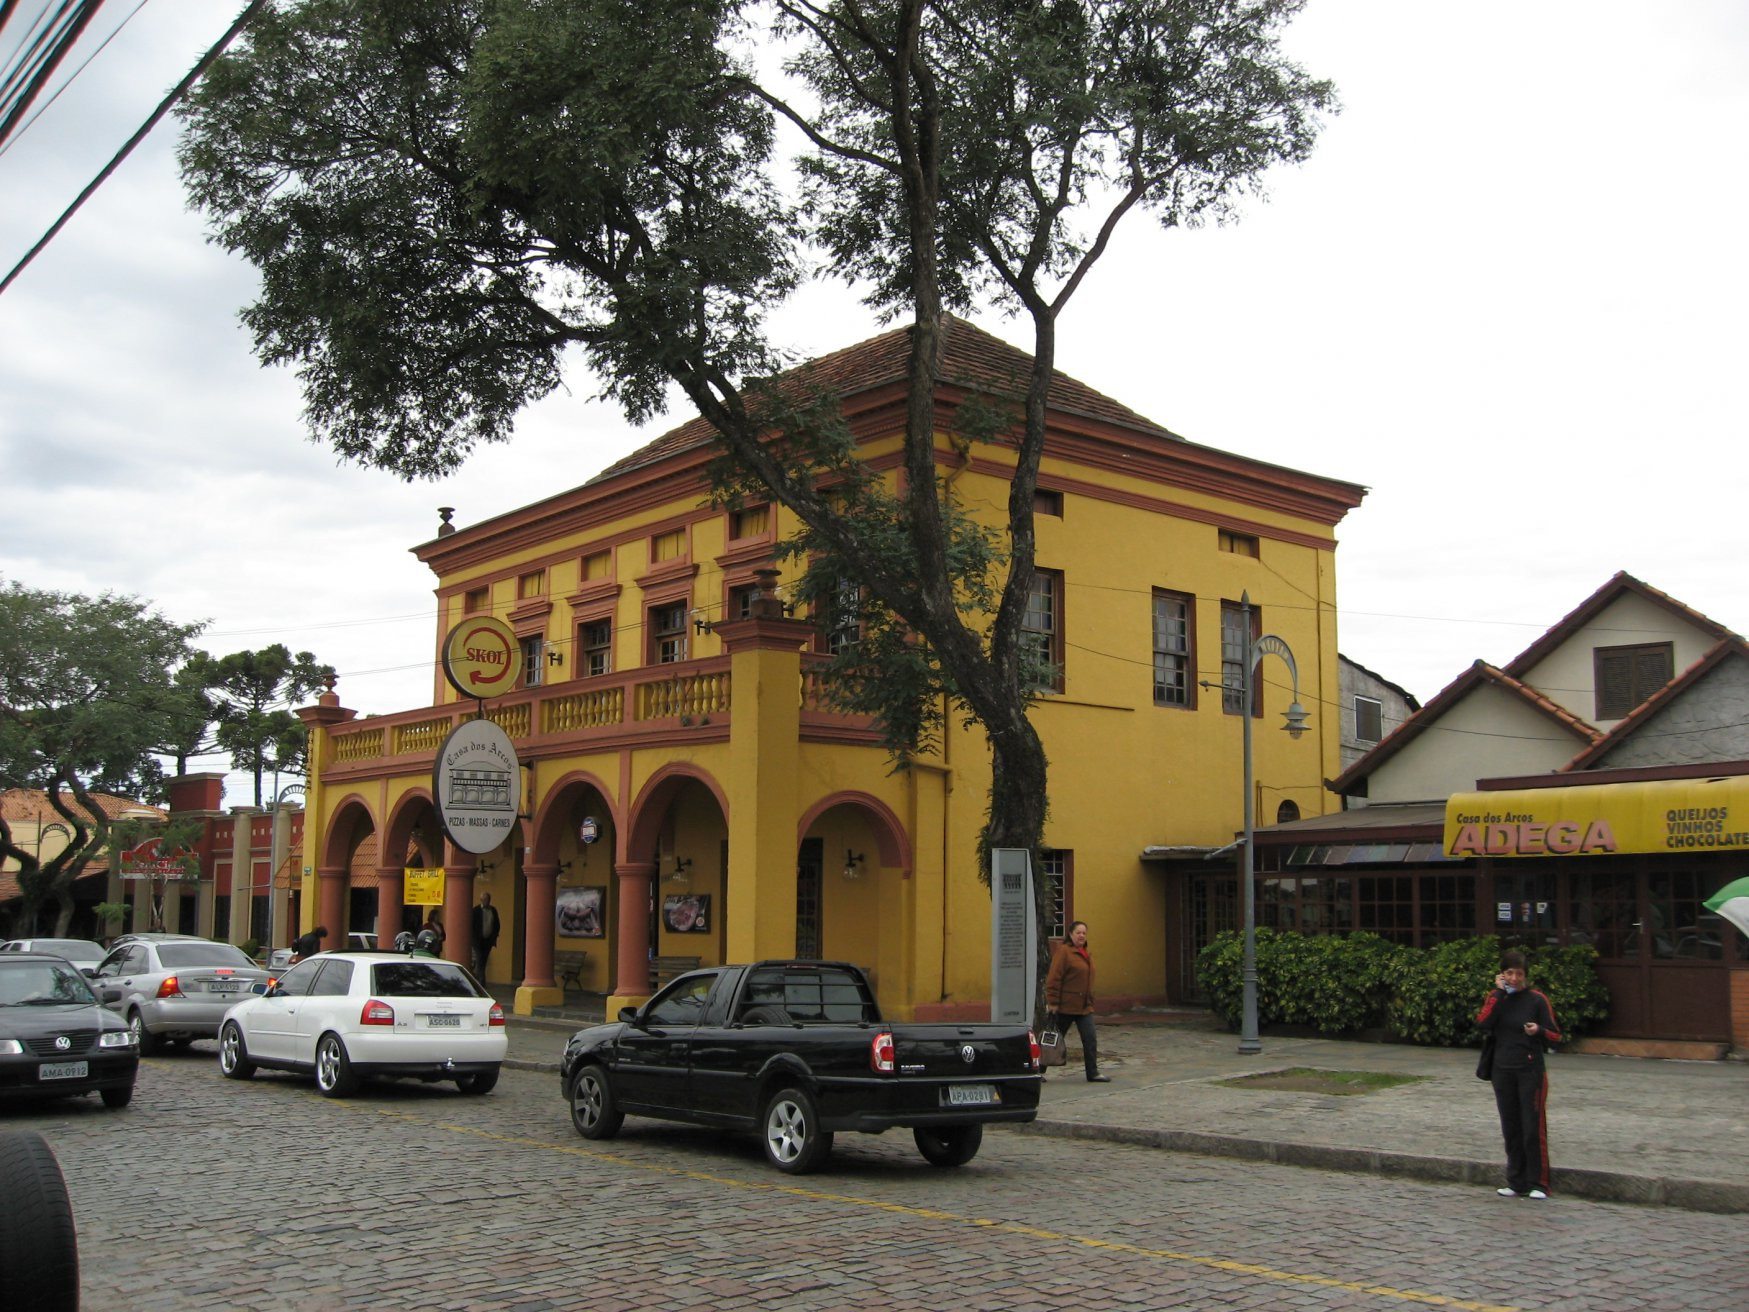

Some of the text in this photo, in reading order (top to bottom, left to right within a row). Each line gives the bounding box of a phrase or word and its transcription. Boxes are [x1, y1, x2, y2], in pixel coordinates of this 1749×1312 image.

[467, 647, 504, 665] SKOL
[447, 741, 512, 769] Casa dos Arcos
[449, 816, 510, 828] PIZZAS MASSAS CARNES
[1456, 811, 1533, 823] Casa dos Arcos
[1667, 807, 1728, 822] QUEIJOS
[1667, 820, 1723, 835] VINHOS
[1449, 819, 1618, 856] ADEGA
[1666, 832, 1749, 848] CHOCOLATE
